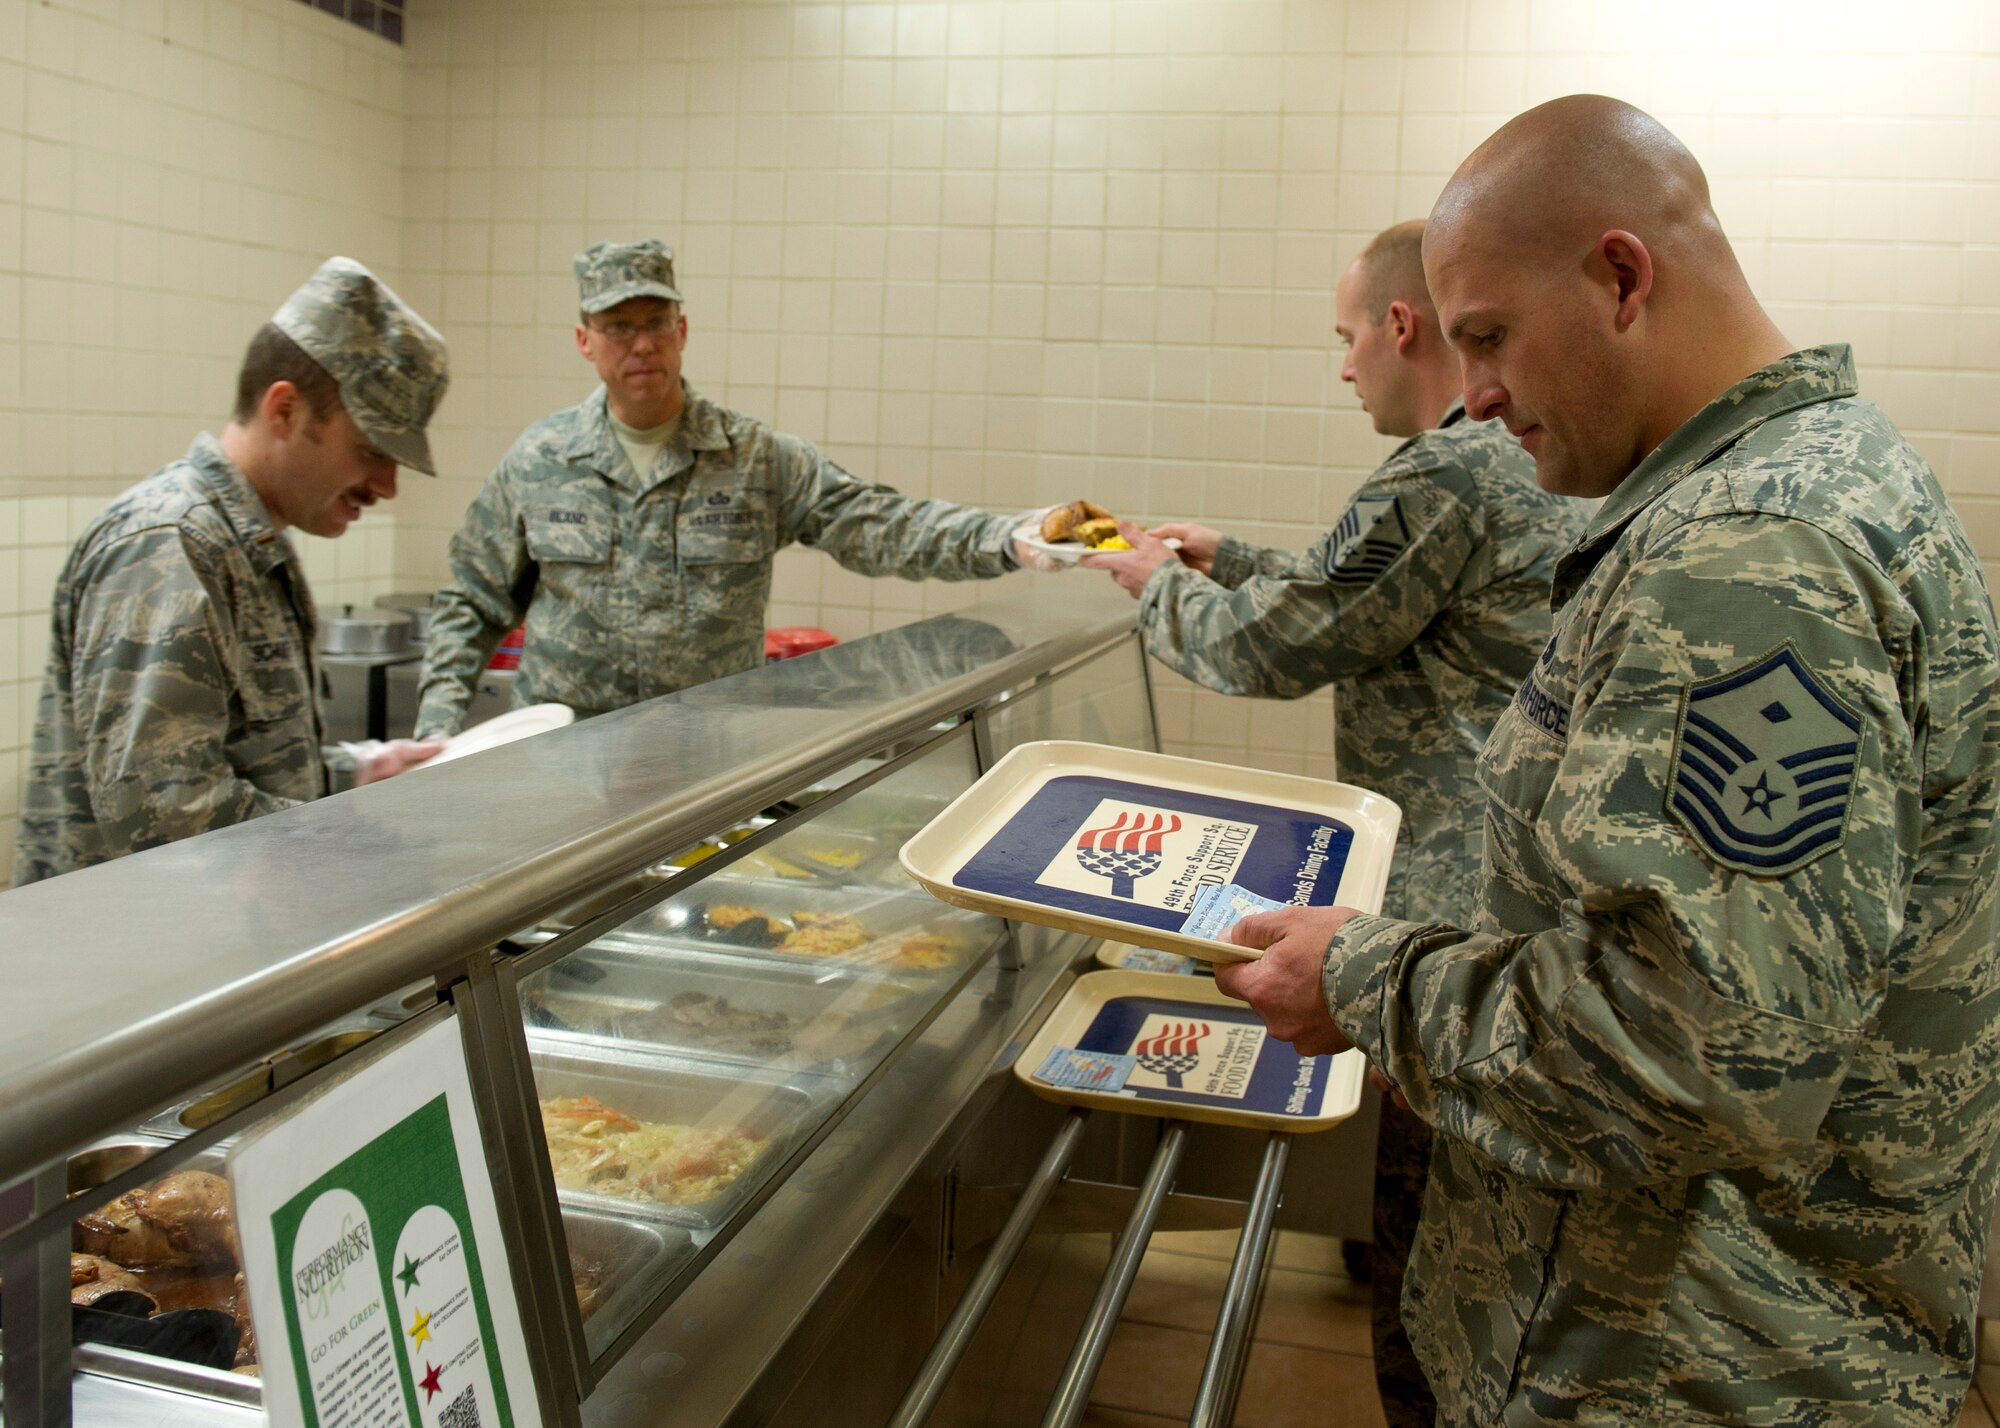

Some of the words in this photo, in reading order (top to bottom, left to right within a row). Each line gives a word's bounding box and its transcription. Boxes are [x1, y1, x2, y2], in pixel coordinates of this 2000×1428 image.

[1523, 684, 1569, 737] FORCE
[1206, 825, 1250, 873] SERVICE
[1307, 825, 1338, 853] Facility
[1163, 888, 1181, 908] 49th
[1172, 863, 1199, 888] Force
[1186, 836, 1216, 863] Support
[1297, 853, 1329, 879] Dining
[1286, 878, 1315, 907] Sands
[1232, 1028, 1263, 1066] SERVICE
[1220, 1067, 1249, 1096] FOOD
[296, 1221, 367, 1279] PERFORMANCE
[296, 1230, 369, 1304] NUTRITION
